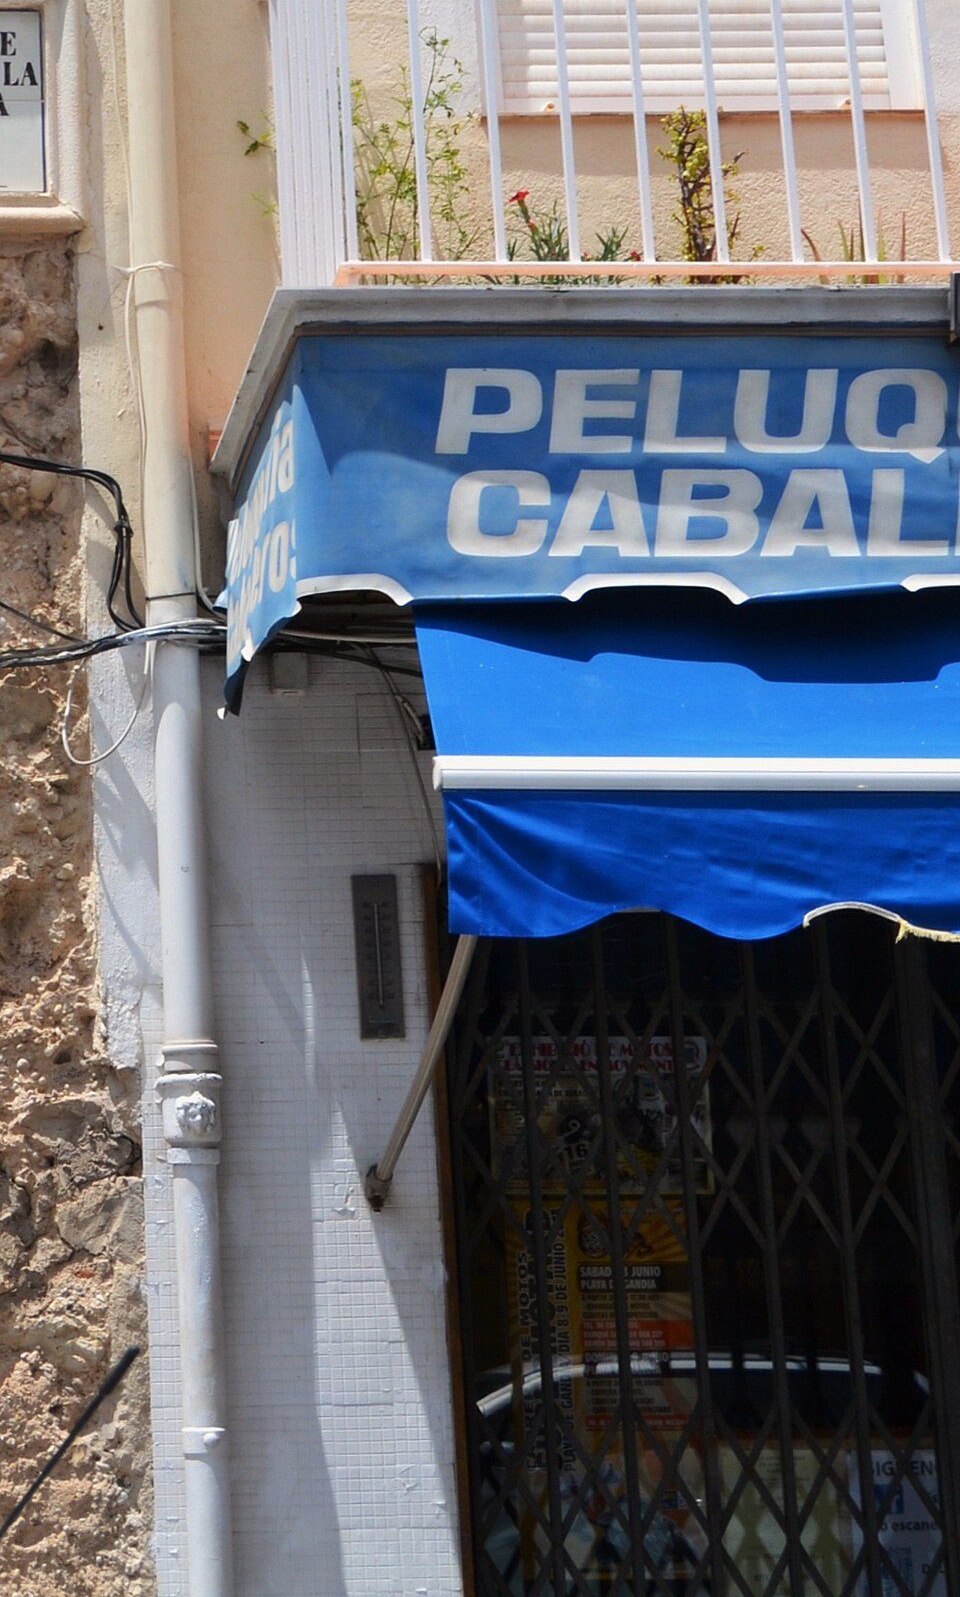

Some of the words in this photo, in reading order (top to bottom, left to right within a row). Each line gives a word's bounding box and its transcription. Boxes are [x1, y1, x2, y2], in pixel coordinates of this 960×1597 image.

[3, 61, 38, 86] LA
[434, 367, 960, 464] PELUQ
[446, 468, 960, 558] CABAL
[580, 1266, 617, 1277] SABAD
